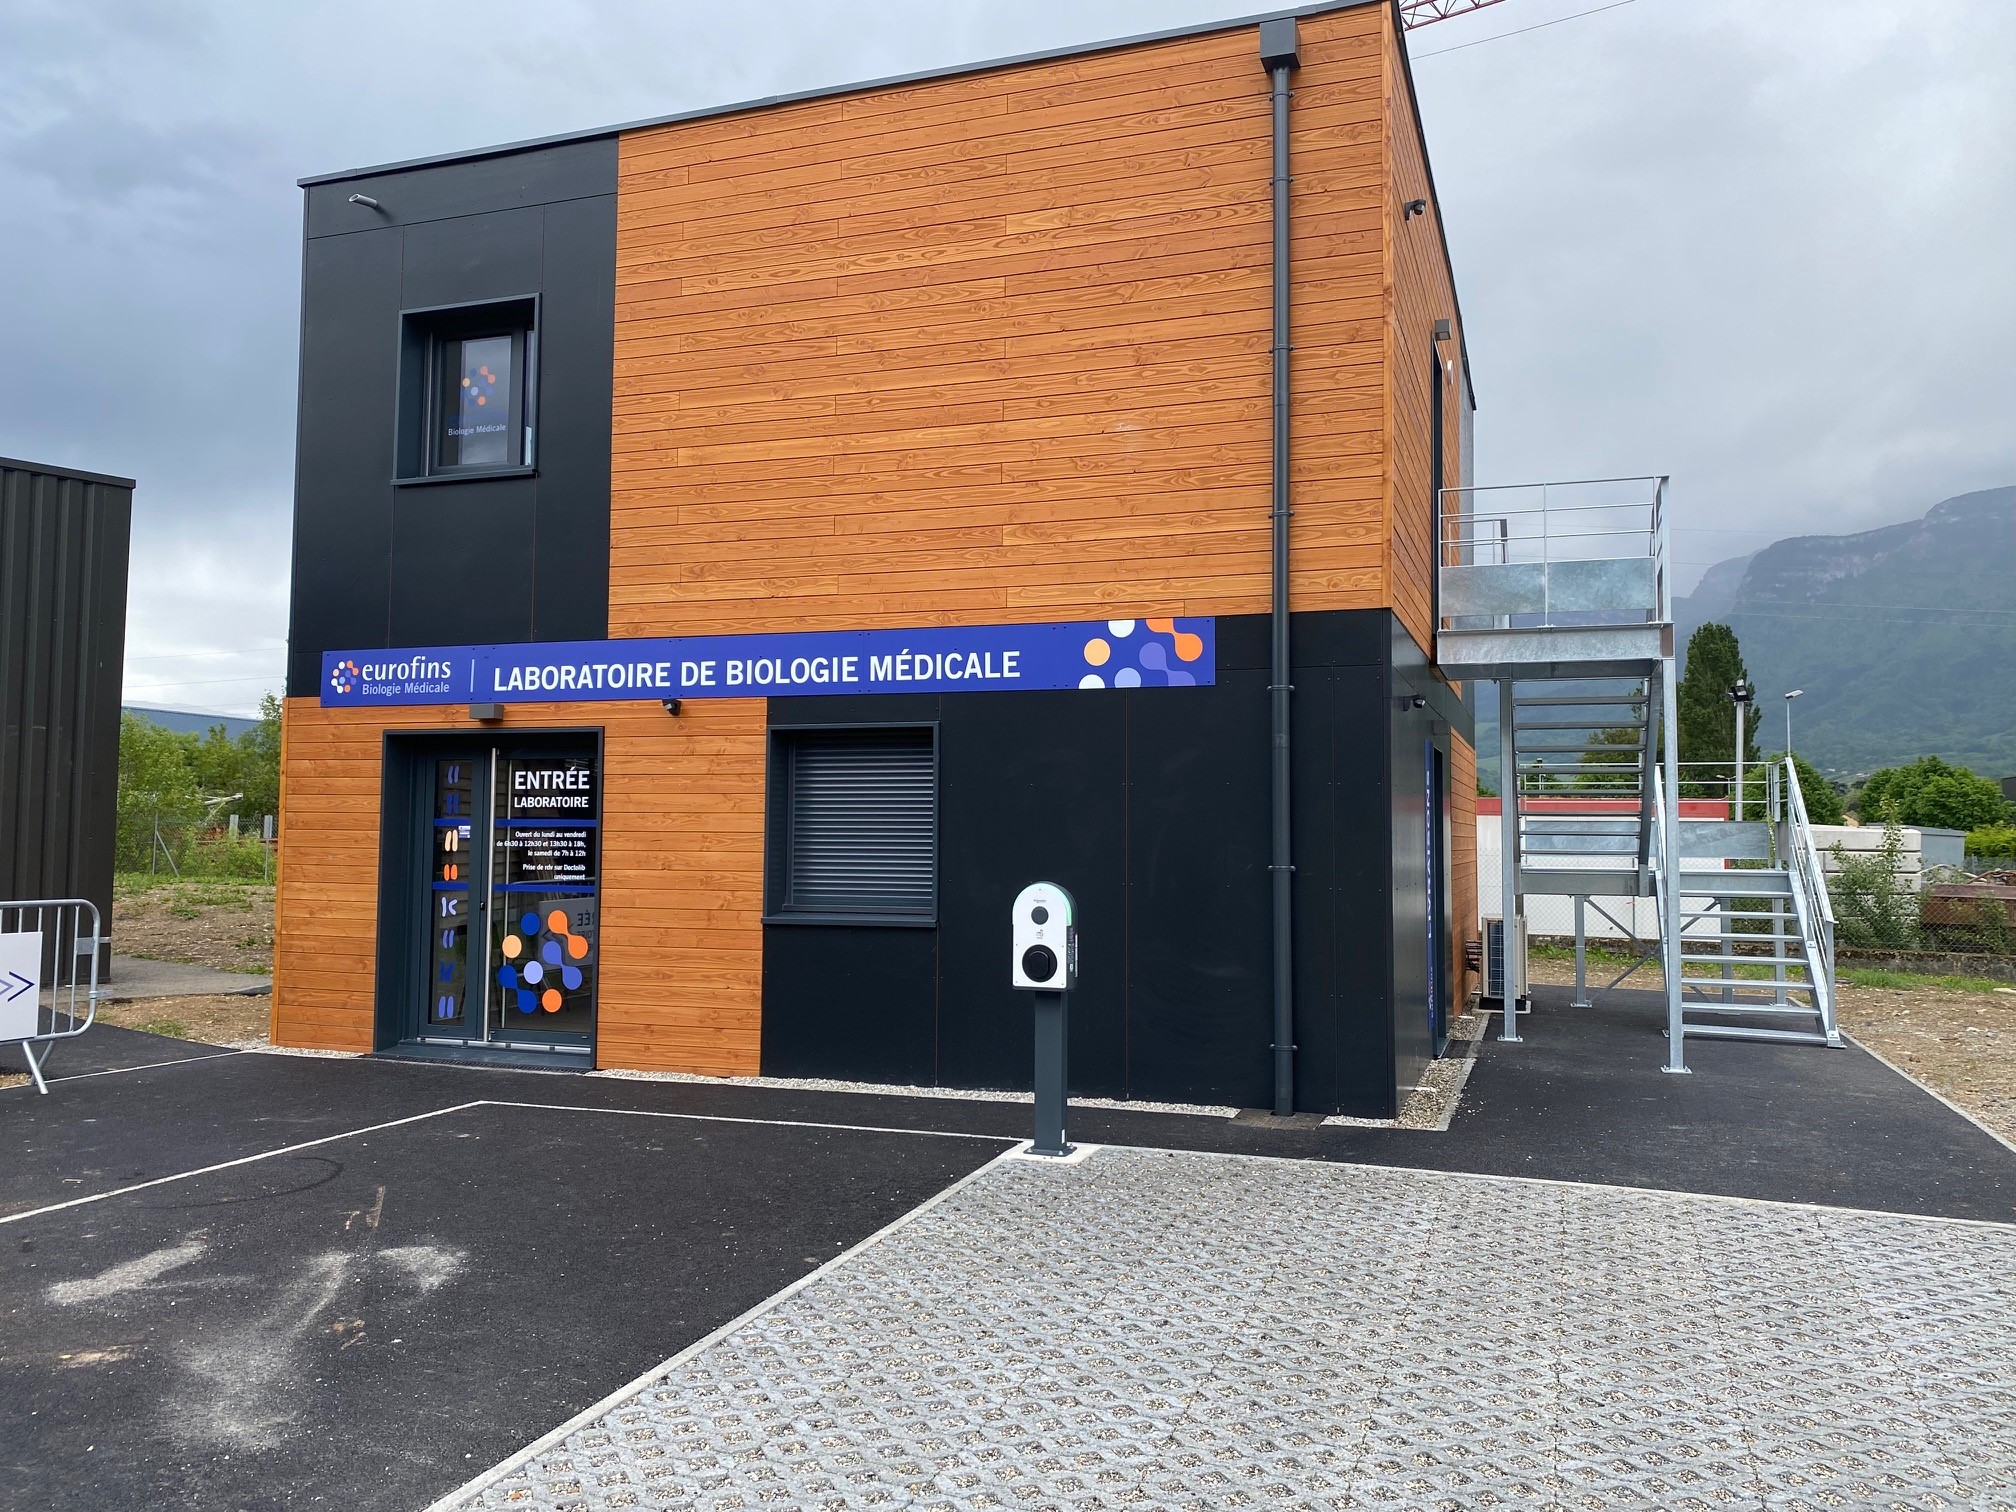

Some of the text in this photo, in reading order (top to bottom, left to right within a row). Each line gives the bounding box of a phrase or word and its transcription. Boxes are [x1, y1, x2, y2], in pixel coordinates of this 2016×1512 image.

[448, 424, 506, 436] Biologie Médicale
[362, 656, 451, 680] eurofins
[493, 648, 1021, 691] LABORATOIRE DE BIOLOGIE MÉDICALE
[362, 681, 450, 697] Biologie Médicale
[514, 766, 590, 790] ENTRÉE
[514, 796, 589, 808] LABORATOIRE
[573, 840, 586, 848] 18h,
